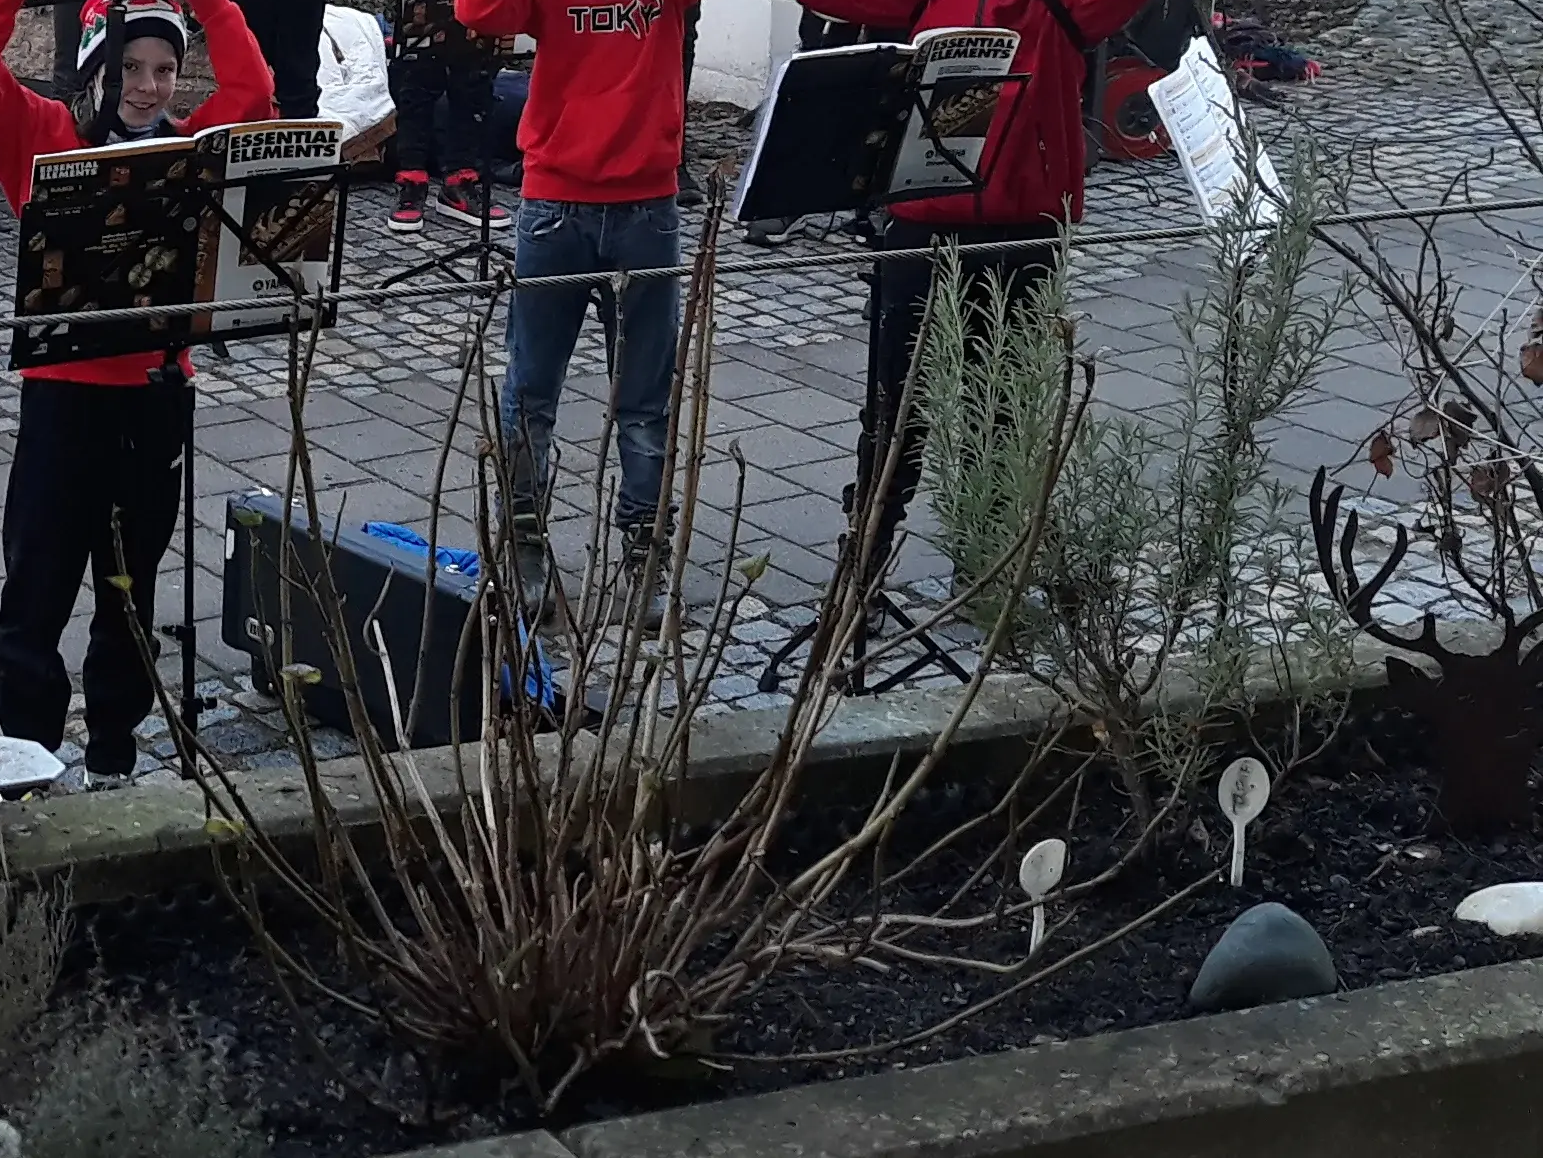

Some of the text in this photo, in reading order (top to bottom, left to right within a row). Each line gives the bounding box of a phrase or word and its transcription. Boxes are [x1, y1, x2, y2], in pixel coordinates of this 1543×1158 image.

[933, 37, 1015, 51] ESSENTIAL
[930, 48, 1013, 62] ELEMENTS
[230, 130, 339, 150] ESSENTIAL
[230, 144, 336, 164] ELEMENTS
